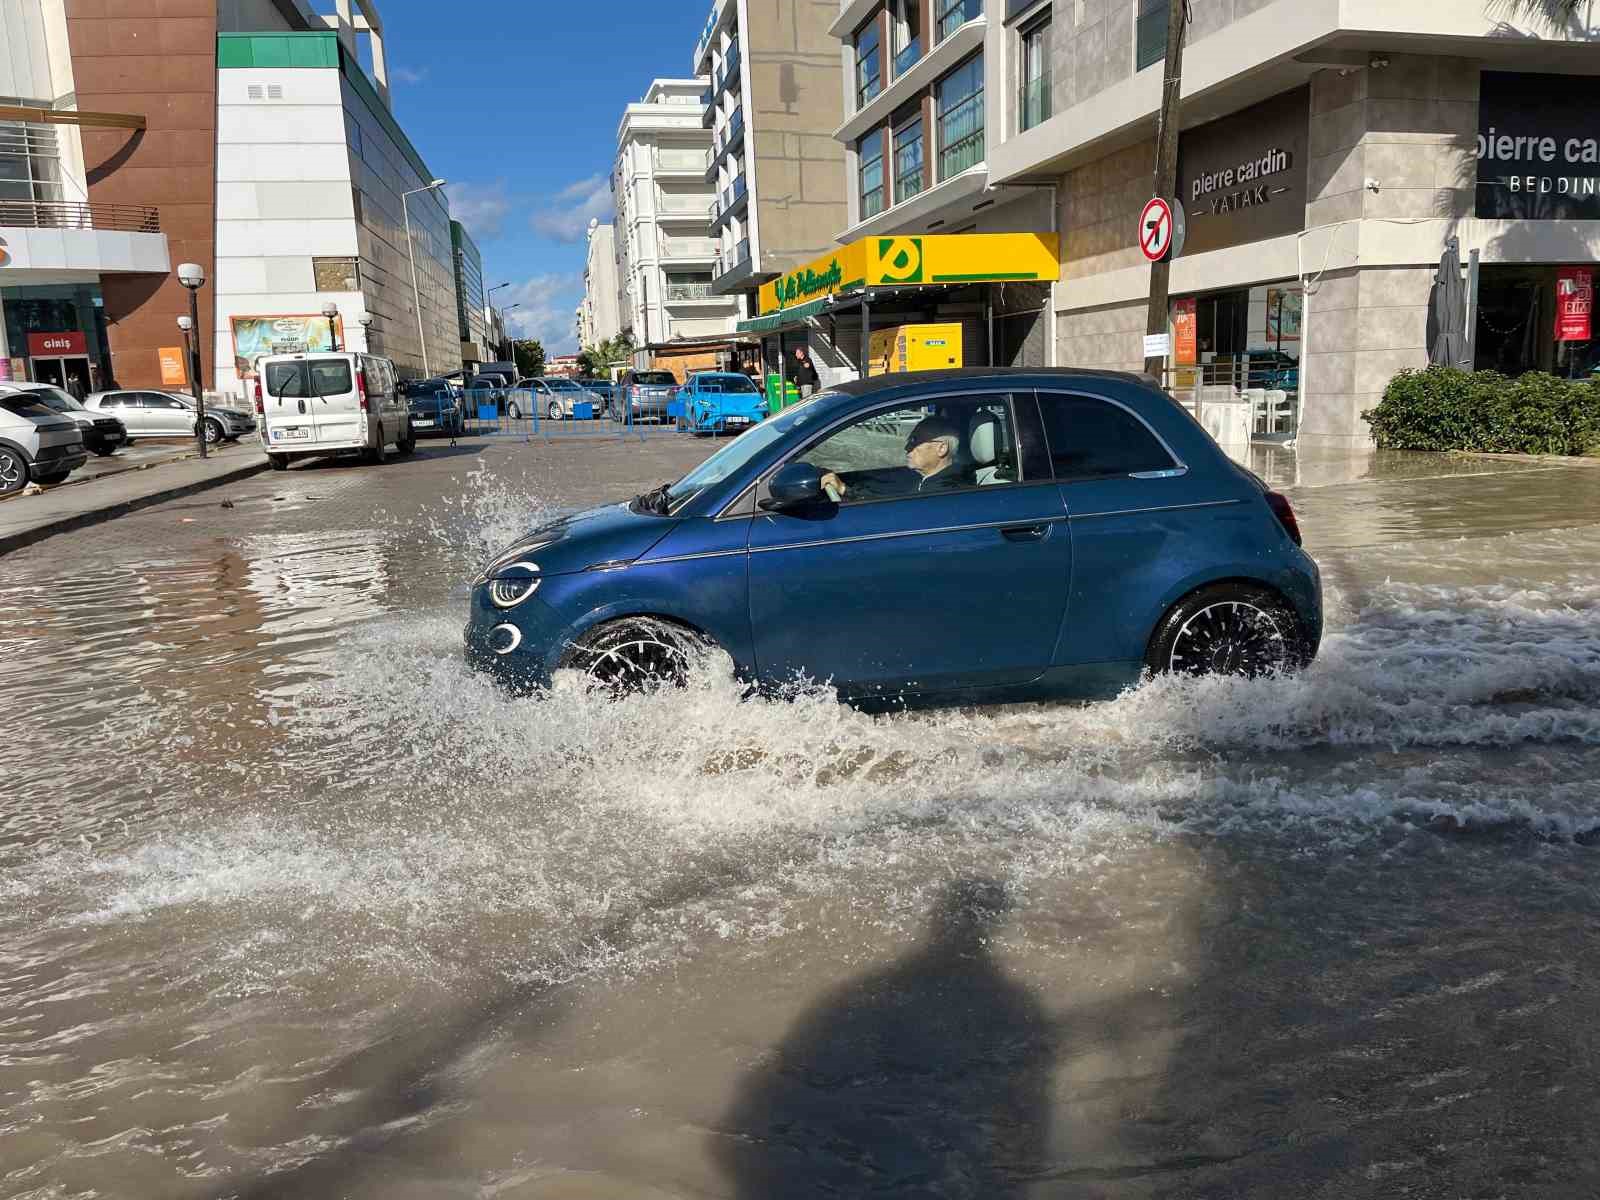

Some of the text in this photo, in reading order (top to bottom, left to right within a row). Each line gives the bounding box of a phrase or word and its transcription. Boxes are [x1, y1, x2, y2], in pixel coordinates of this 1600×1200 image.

[1564, 136, 1600, 163] ca
[1192, 148, 1286, 201] pierre cardin
[1510, 175, 1600, 194] BEDDIN
[1210, 183, 1264, 216] YATAK
